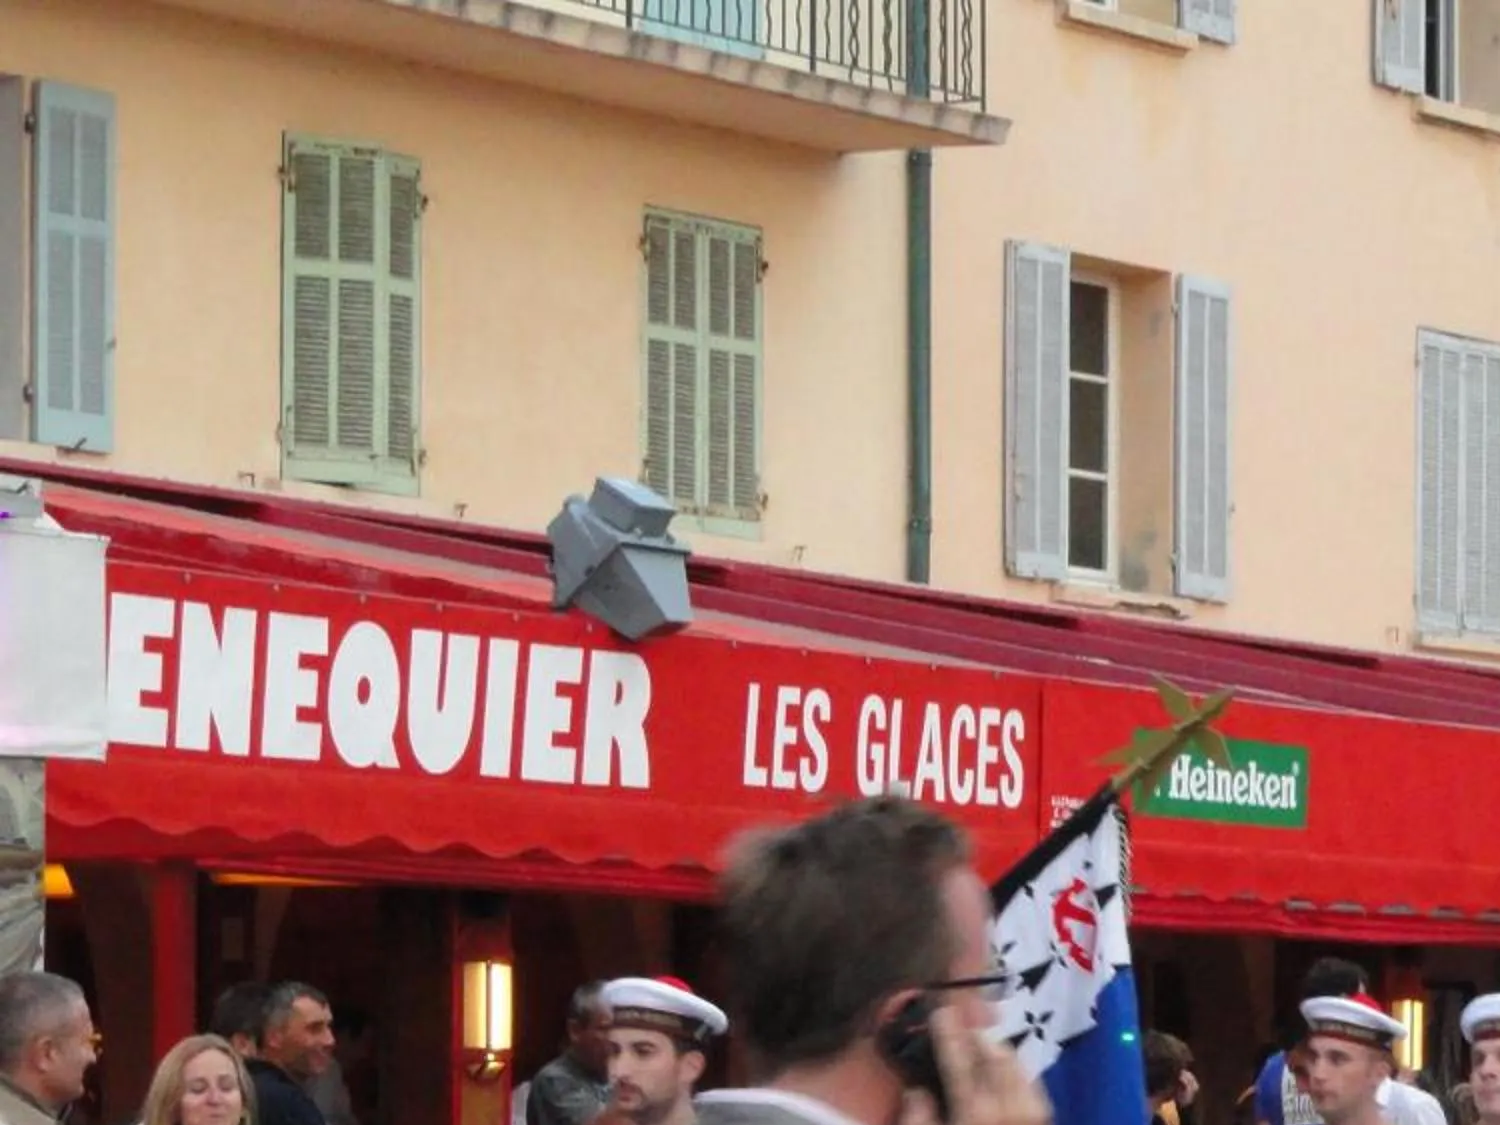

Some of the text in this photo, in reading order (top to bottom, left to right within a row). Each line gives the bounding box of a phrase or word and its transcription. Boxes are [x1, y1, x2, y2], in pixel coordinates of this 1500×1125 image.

[107, 591, 652, 790] ENEQUIER
[743, 682, 1025, 809] LES GLACES
[1168, 753, 1298, 810] Heineken
